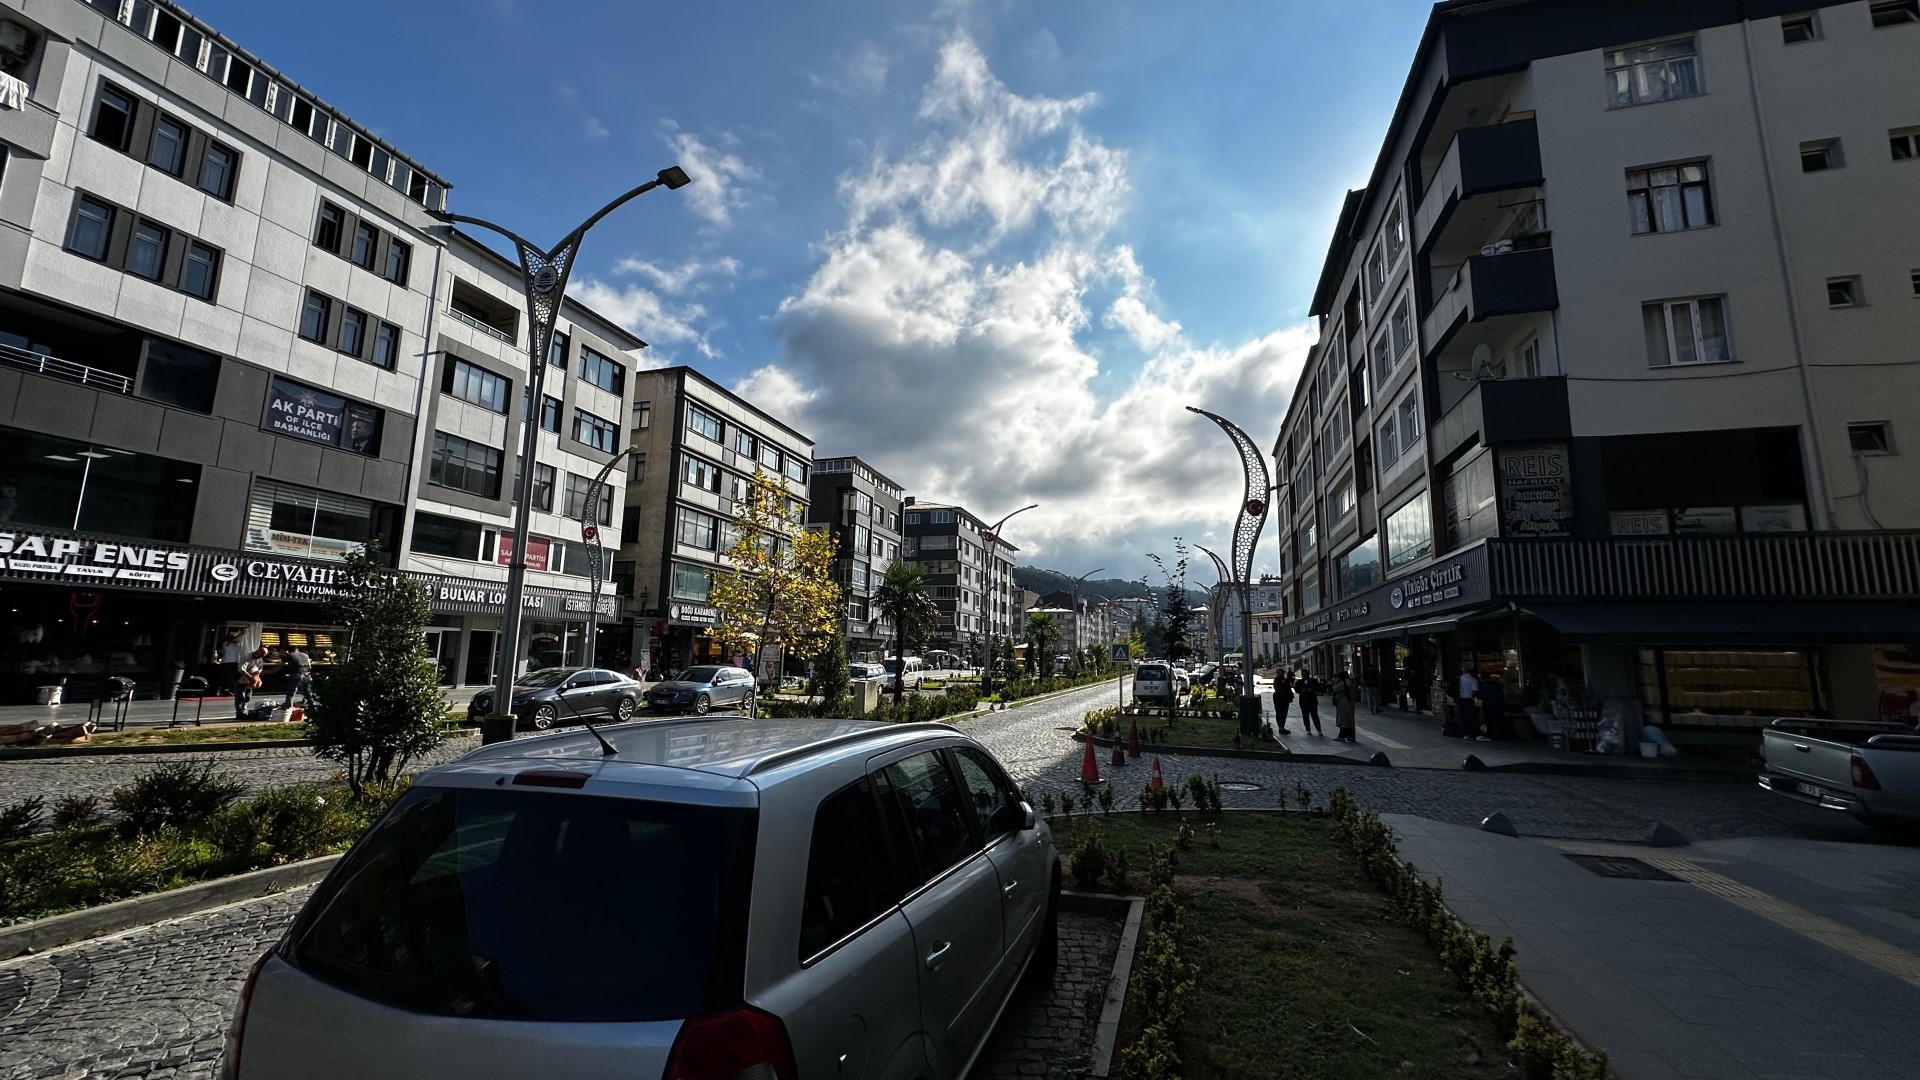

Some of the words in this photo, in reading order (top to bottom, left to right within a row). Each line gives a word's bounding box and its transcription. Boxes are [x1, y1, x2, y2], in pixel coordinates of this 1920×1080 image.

[271, 398, 295, 414] AK
[273, 420, 331, 441] BAŞKANLIĞI
[285, 415, 300, 424] OF
[302, 419, 323, 431] İLÇE
[1504, 448, 1563, 478] REİS
[1508, 478, 1562, 486] HAFRİYAT
[93, 543, 190, 570] ENES
[77, 567, 104, 575] TAVUK
[129, 571, 152, 579] KÖFTE
[440, 587, 485, 603] BULVAR
